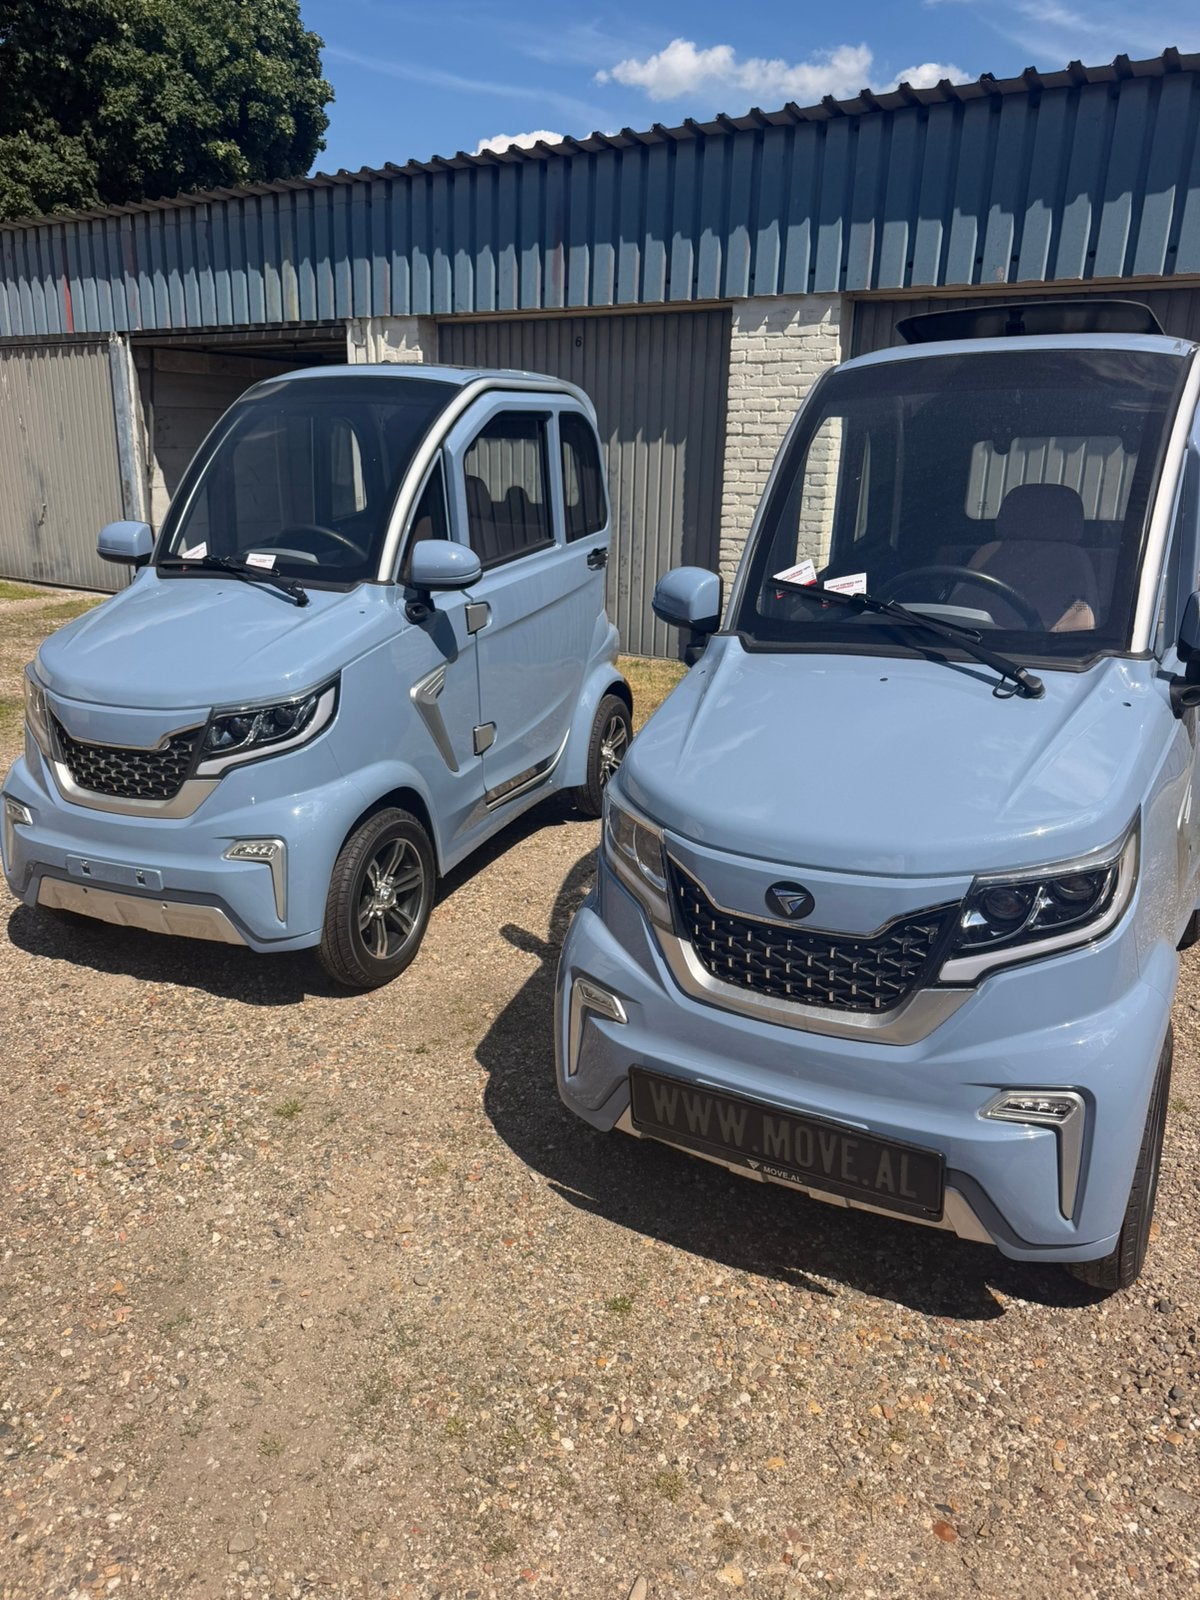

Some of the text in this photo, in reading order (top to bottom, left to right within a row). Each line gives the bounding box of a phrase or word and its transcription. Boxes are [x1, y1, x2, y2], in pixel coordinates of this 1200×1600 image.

[575, 336, 583, 348] 6
[648, 1080, 917, 1198] WWW.MOVE.AL
[763, 1165, 803, 1184] MOVE.AL
